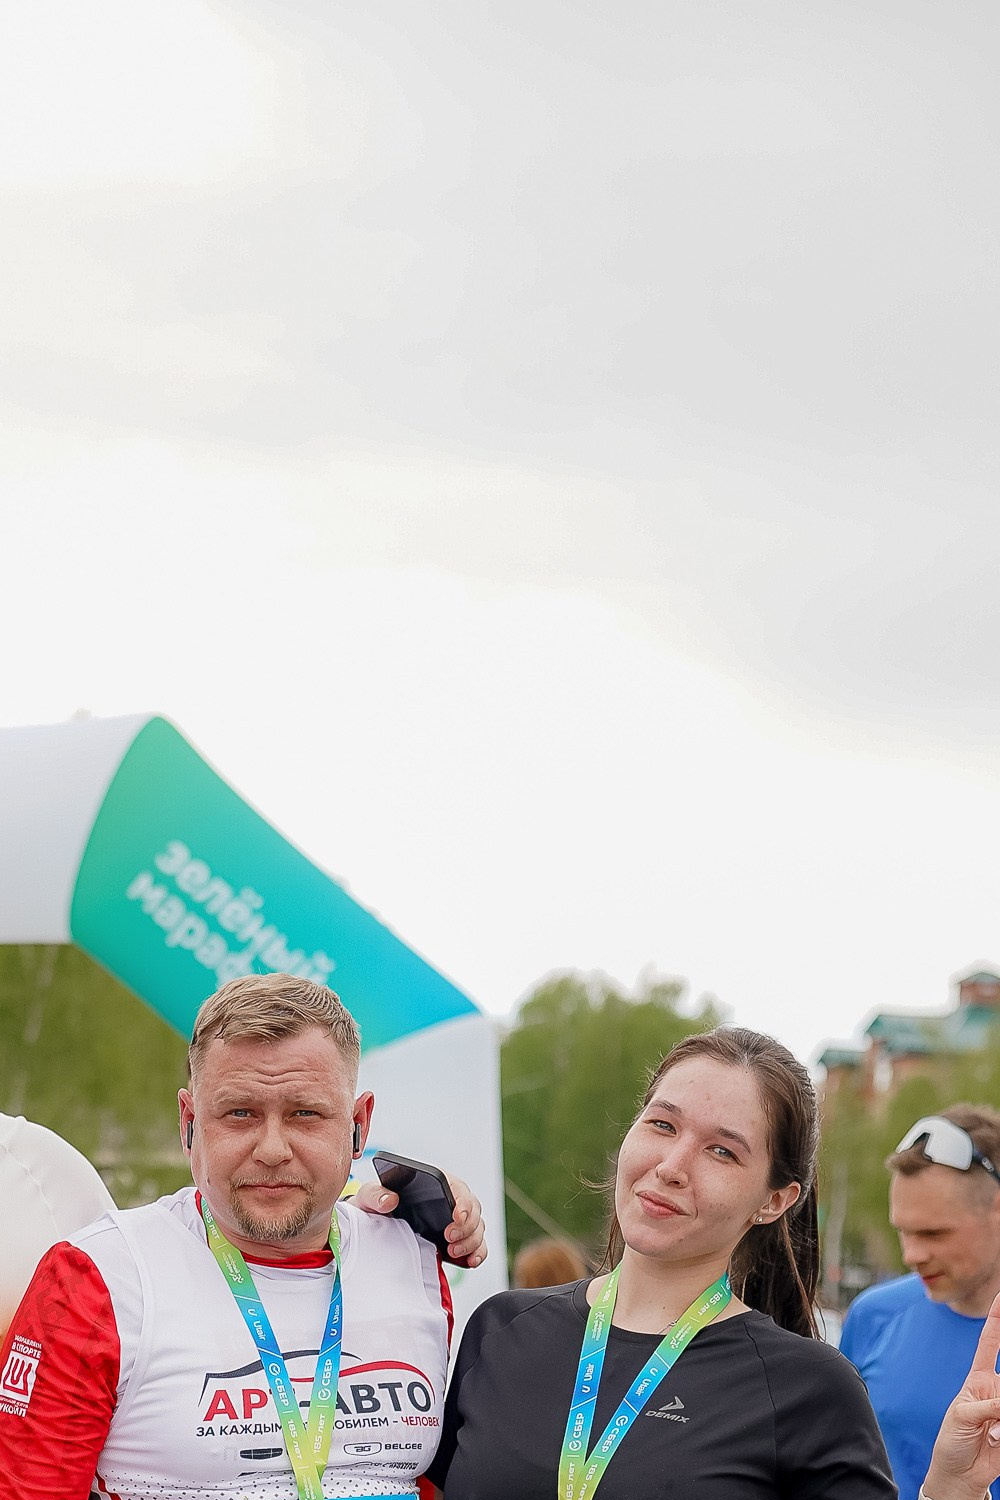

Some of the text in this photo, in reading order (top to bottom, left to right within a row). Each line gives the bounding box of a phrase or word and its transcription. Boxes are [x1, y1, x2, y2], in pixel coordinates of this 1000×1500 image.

[127, 871, 254, 990] мараф
[322, 1359, 333, 1386] СБЕР
[203, 1381, 432, 1422] АР-ВТО
[274, 1378, 290, 1407] СБЕР
[196, 1425, 216, 1437] ЗА
[219, 1423, 283, 1436] КАЖДЫМ
[400, 1416, 440, 1428] ЧЕЛОВЕК
[573, 1412, 585, 1438] СБЕР
[645, 1410, 691, 1424] DEMIX
[384, 1442, 423, 1451] BELGEE
[602, 1428, 620, 1453] СБЕР
